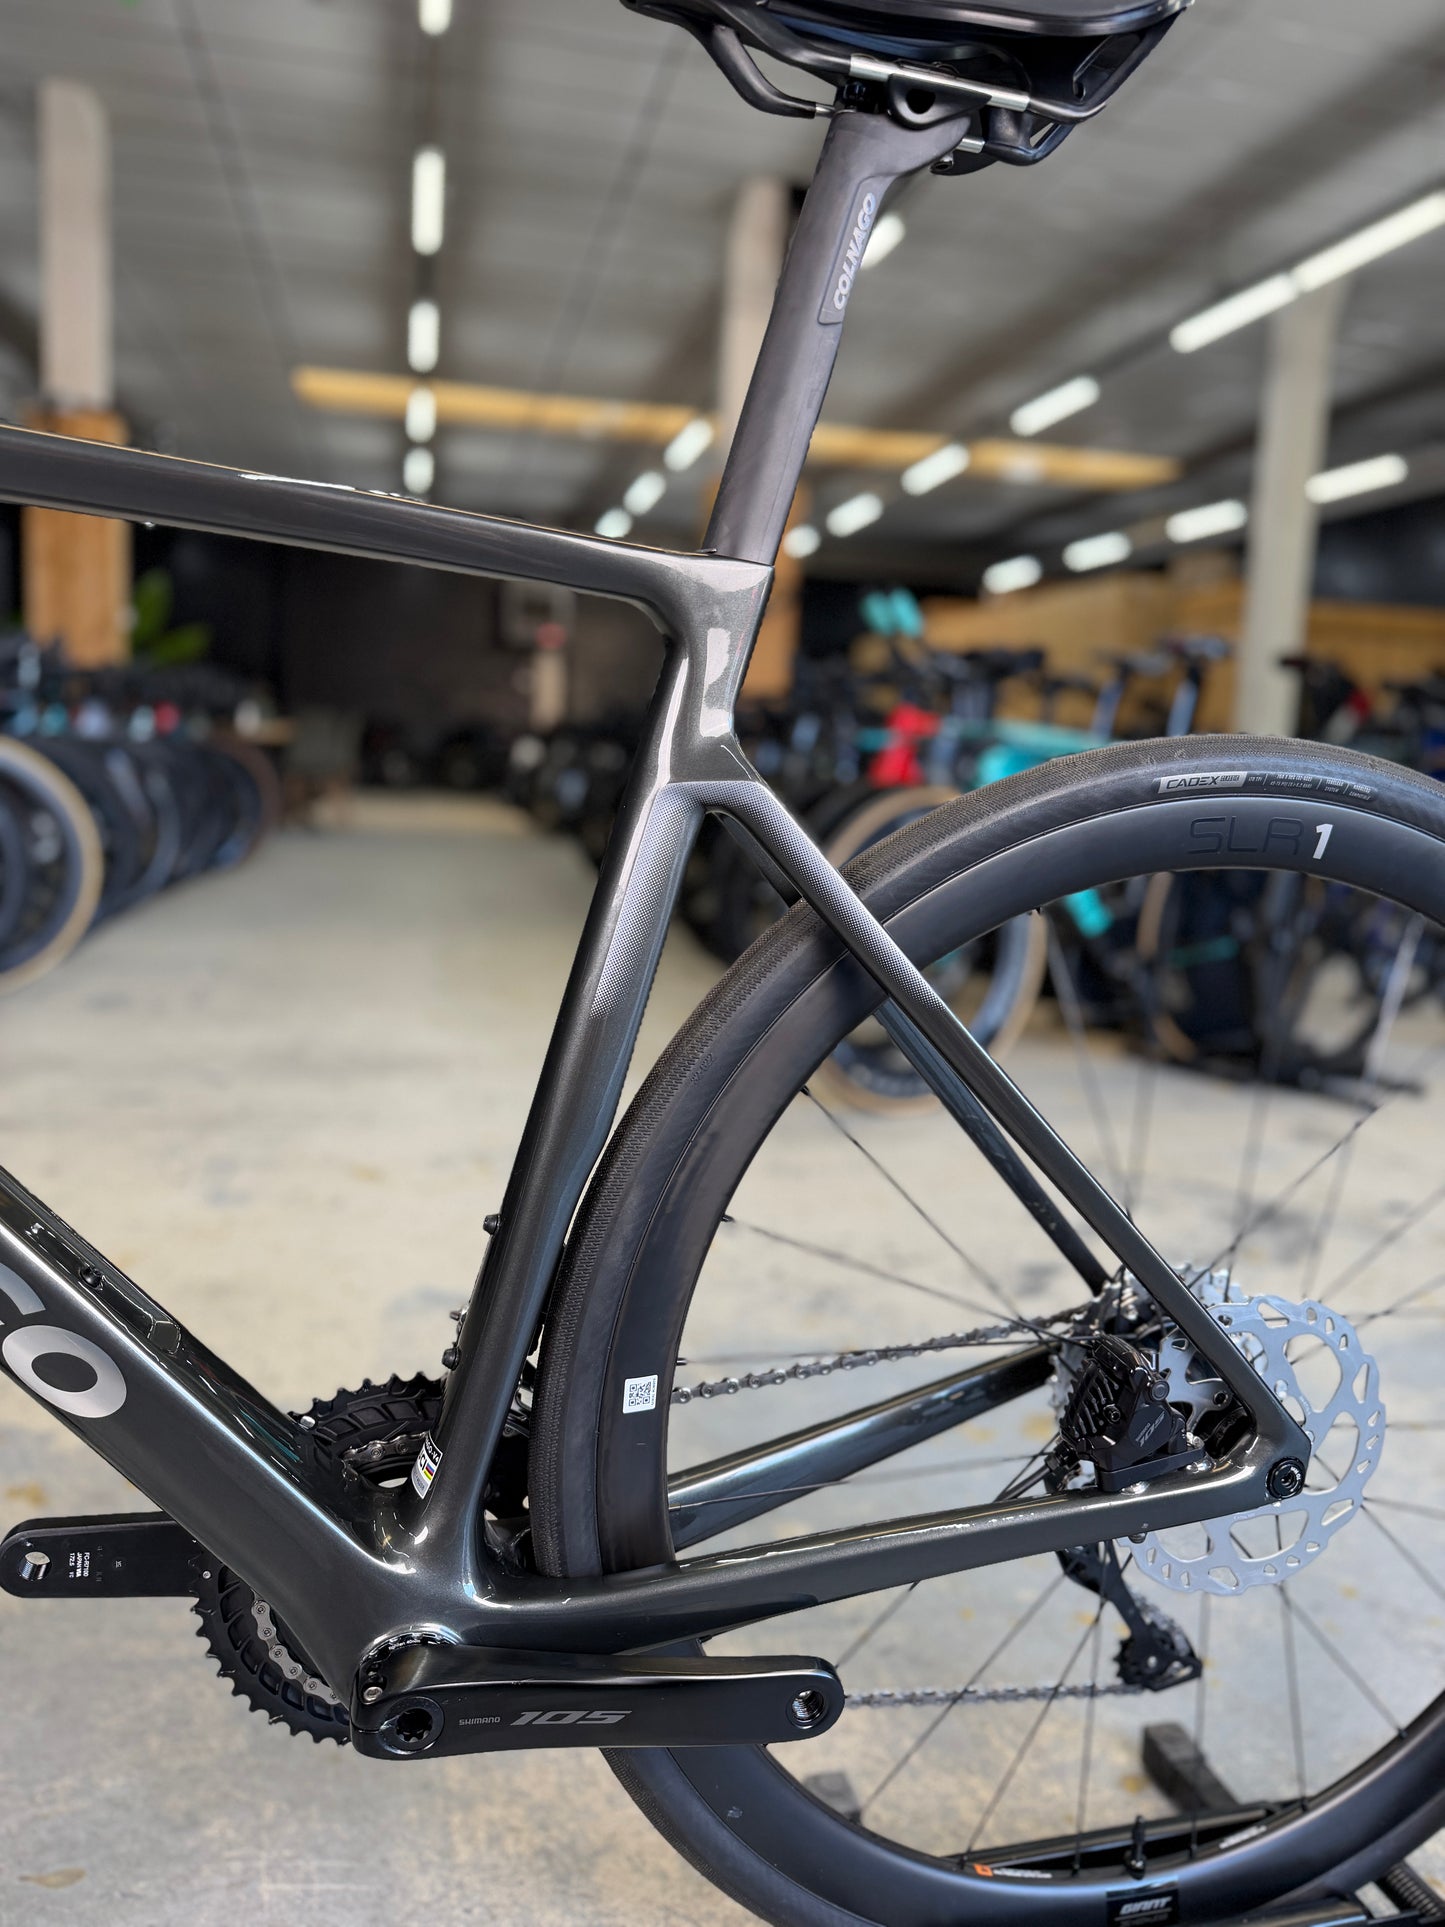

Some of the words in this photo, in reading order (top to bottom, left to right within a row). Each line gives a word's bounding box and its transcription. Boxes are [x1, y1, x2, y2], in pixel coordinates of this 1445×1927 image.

[833, 192, 876, 311] COLNAGO
[1166, 775, 1220, 790] CADEX
[1188, 816, 1304, 855] SLR
[1312, 823, 1334, 860] 1
[458, 1716, 501, 1727] SHIMANO
[510, 1710, 632, 1727] 105
[1120, 1896, 1172, 1915] GIANT
